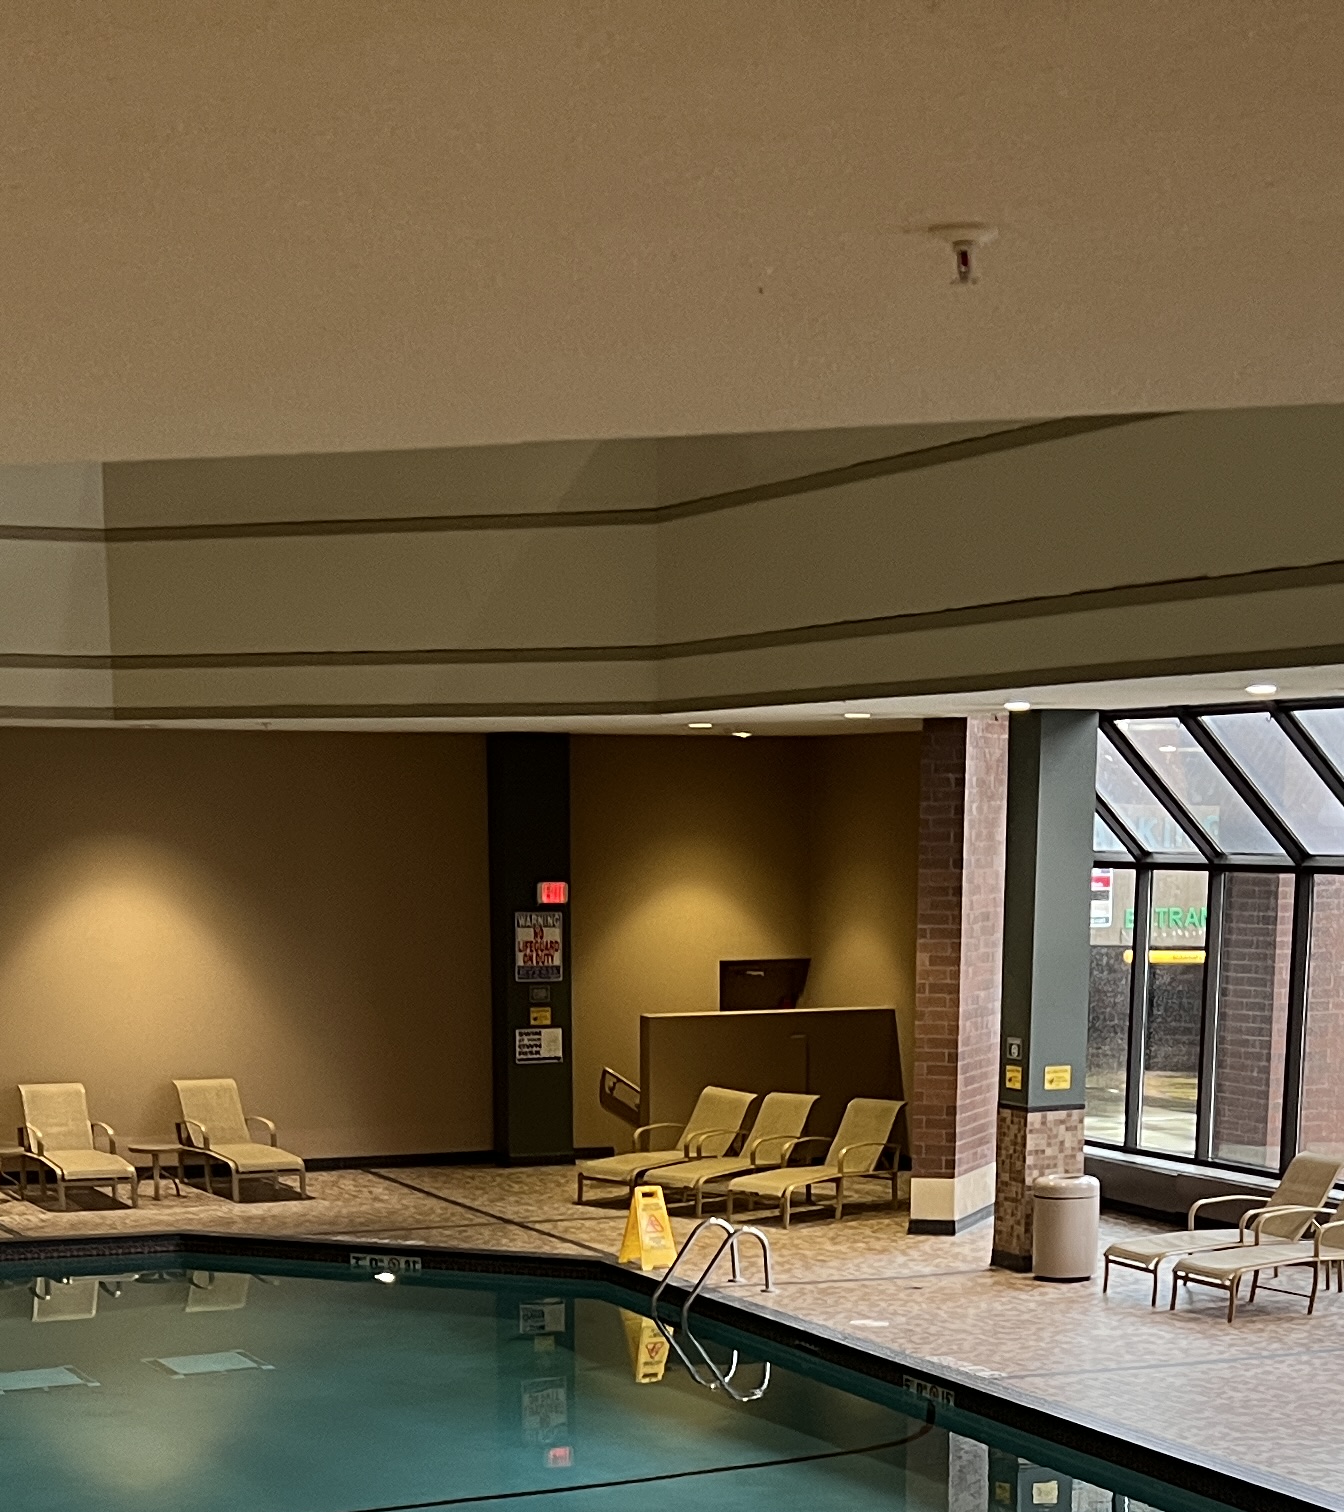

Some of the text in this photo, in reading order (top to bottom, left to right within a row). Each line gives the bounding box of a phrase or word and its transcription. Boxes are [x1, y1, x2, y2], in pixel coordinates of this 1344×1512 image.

[518, 914, 560, 927] WARNING
[533, 927, 544, 940] NO
[518, 940, 560, 953] LIFEGUARD
[523, 953, 555, 965] ON DUTY
